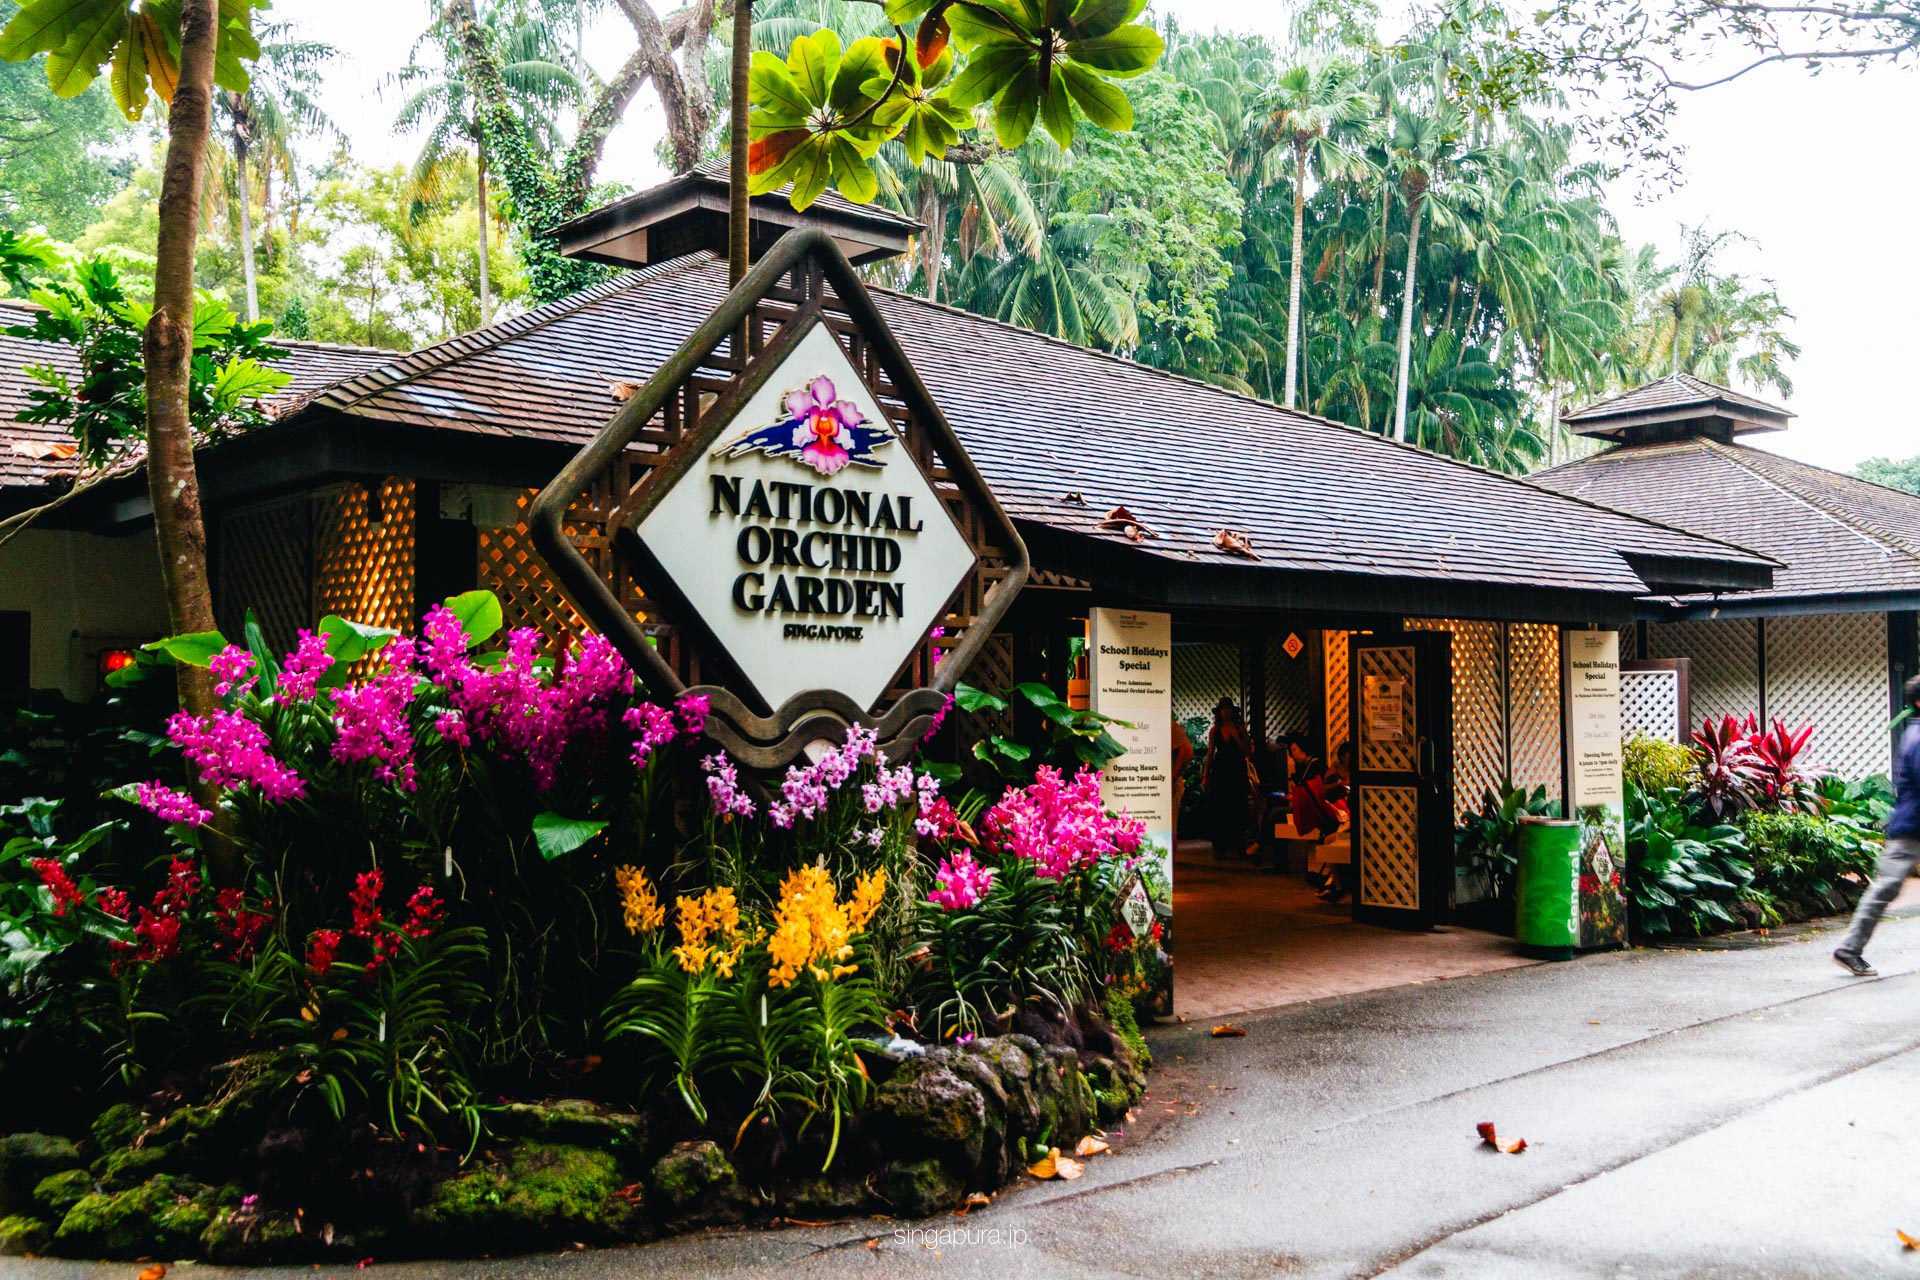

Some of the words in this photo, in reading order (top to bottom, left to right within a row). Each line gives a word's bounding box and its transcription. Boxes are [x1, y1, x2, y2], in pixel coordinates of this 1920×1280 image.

[710, 474, 923, 532] NATIONAL
[737, 525, 902, 573] ORCHID
[732, 572, 905, 618] GARDEN
[783, 623, 863, 640] SINGAPORE
[1100, 645, 1129, 655] School
[1132, 646, 1168, 658] Holidays
[1119, 660, 1150, 671] Special
[1593, 661, 1617, 669] Holidays
[1585, 672, 1605, 681] Special
[1137, 721, 1149, 732] May
[1130, 746, 1142, 755] June
[1144, 746, 1158, 754] 2017
[1113, 764, 1138, 772] Opening
[1151, 774, 1165, 782] daily
[1567, 850, 1580, 934] General
